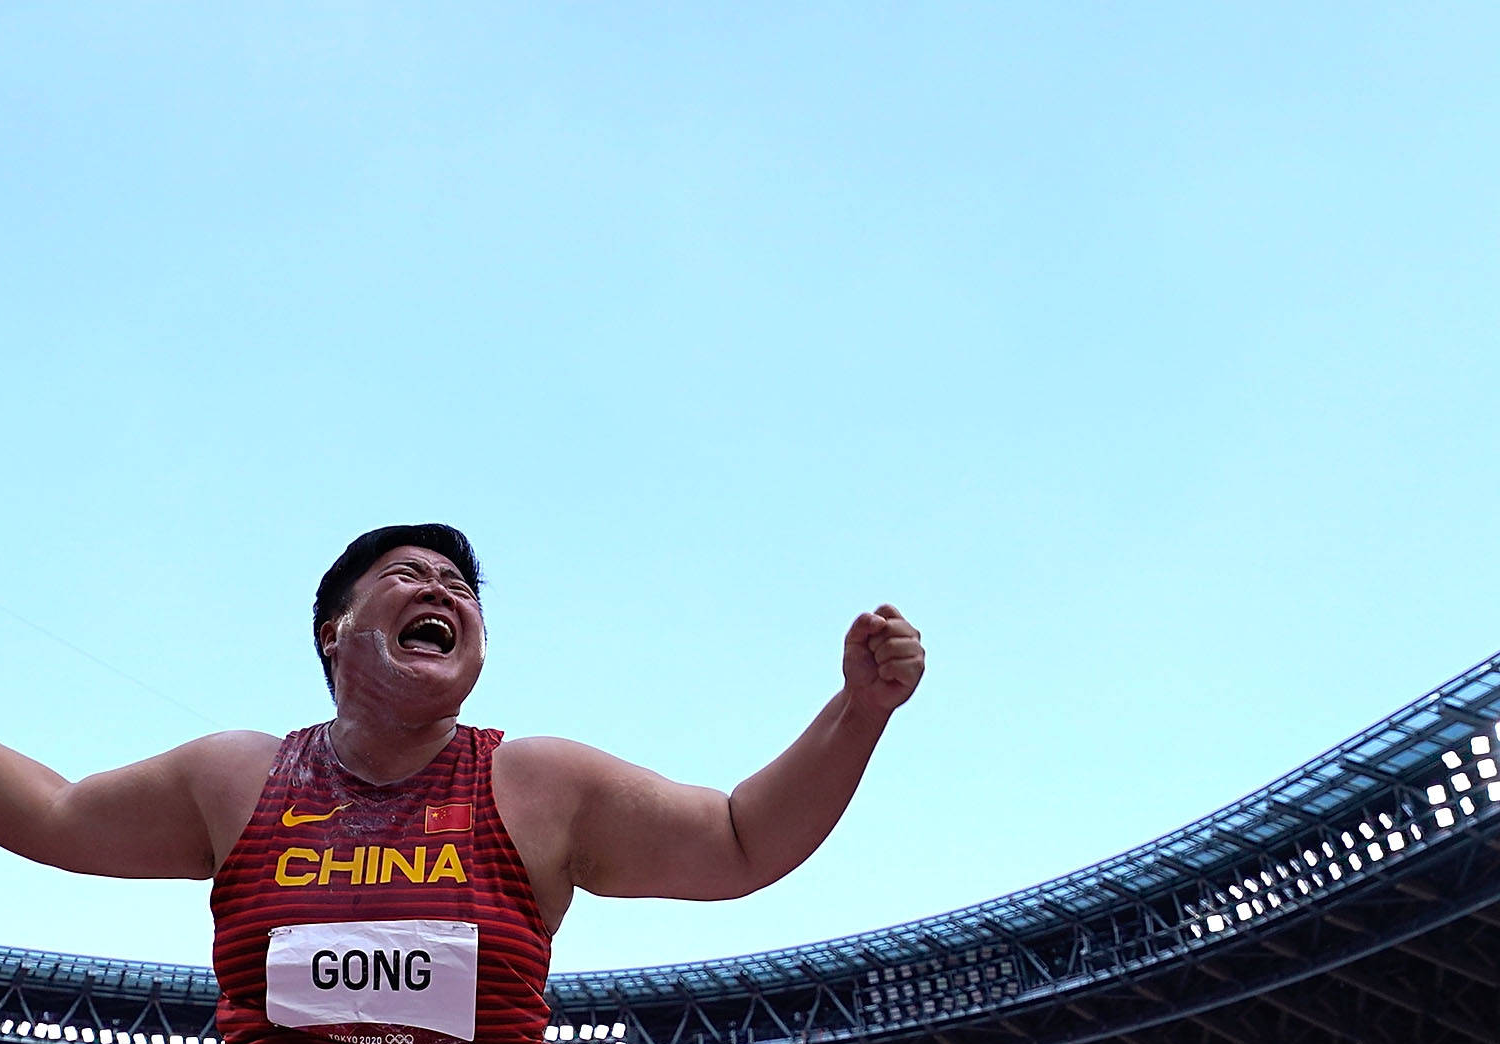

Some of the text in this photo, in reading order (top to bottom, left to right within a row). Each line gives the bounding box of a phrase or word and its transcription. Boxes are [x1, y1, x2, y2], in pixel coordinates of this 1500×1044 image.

[275, 844, 467, 886] CHINA
[312, 949, 432, 991] GONG
[329, 1034, 357, 1044] TOKYO
